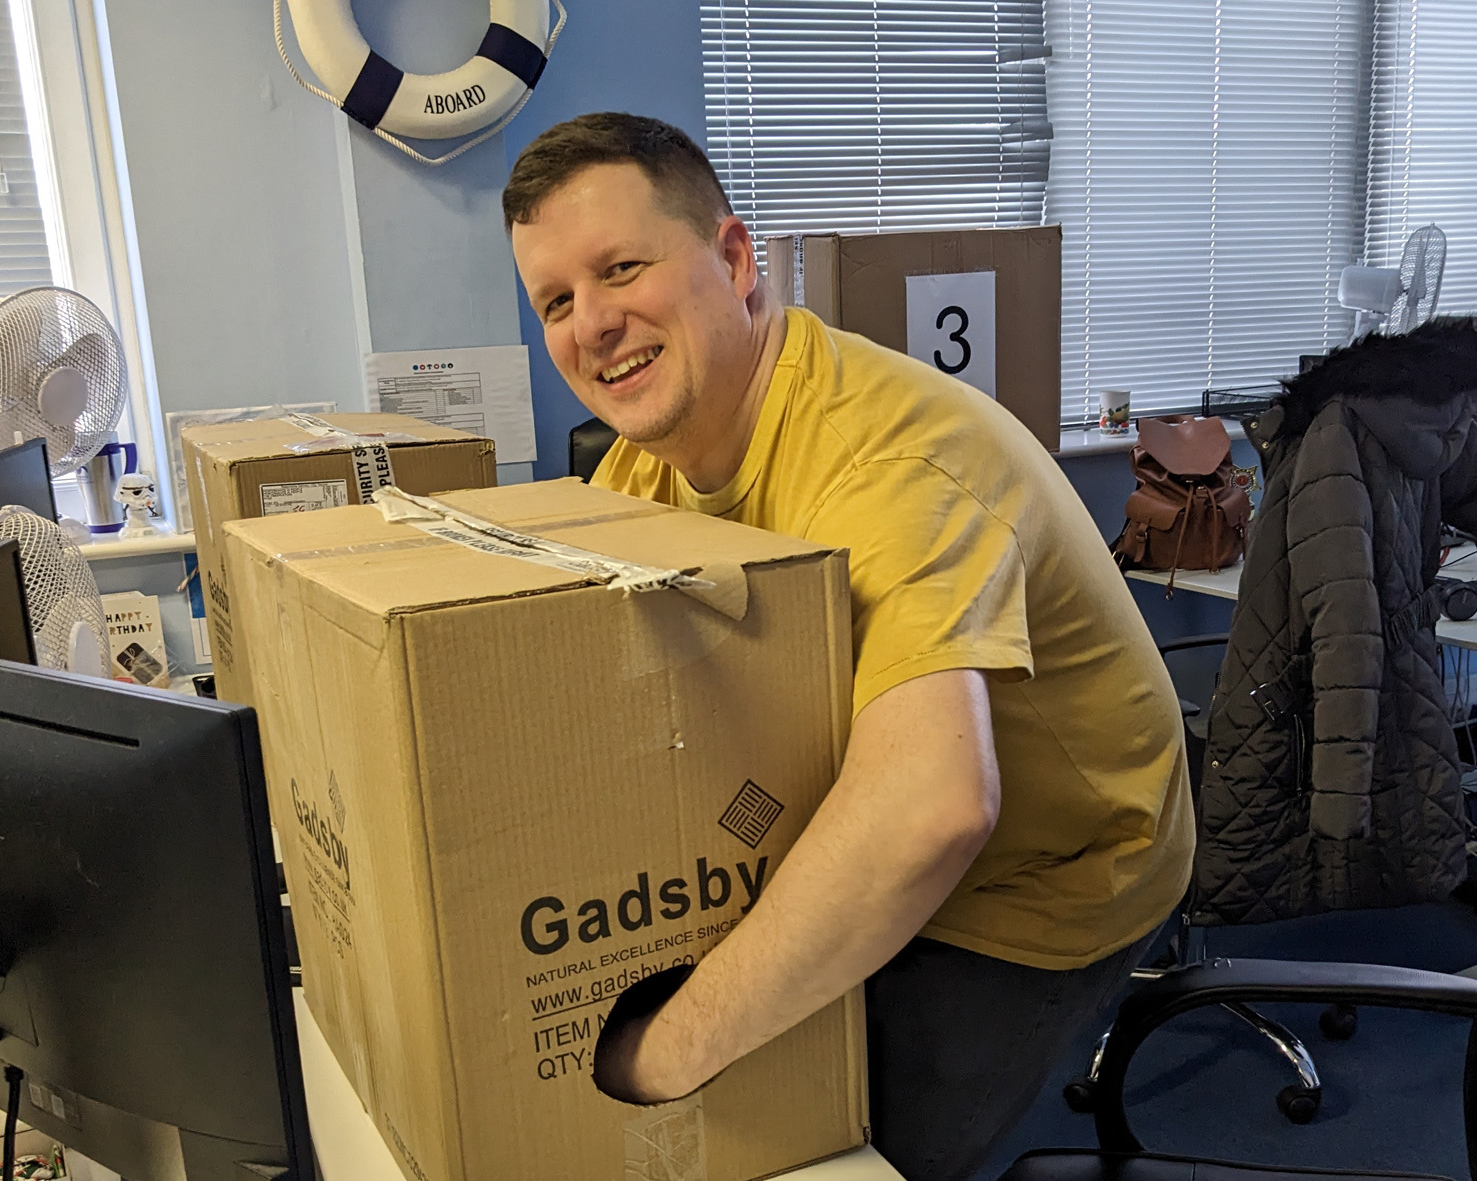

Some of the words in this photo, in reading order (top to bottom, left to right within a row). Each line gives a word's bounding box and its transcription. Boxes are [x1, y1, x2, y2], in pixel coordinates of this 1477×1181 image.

[424, 84, 486, 114] ABOARD
[934, 305, 971, 374] 3
[356, 462, 374, 504] CURITY
[106, 611, 141, 623] HAPPY
[109, 623, 152, 635] RTHDAY
[291, 777, 351, 891] Gadsby
[521, 856, 768, 956] Gadsby
[526, 960, 597, 988] NATURAL
[600, 931, 694, 967] EXCELLENCE
[533, 1017, 591, 1053] ITEM
[537, 1047, 594, 1081] QTY:
